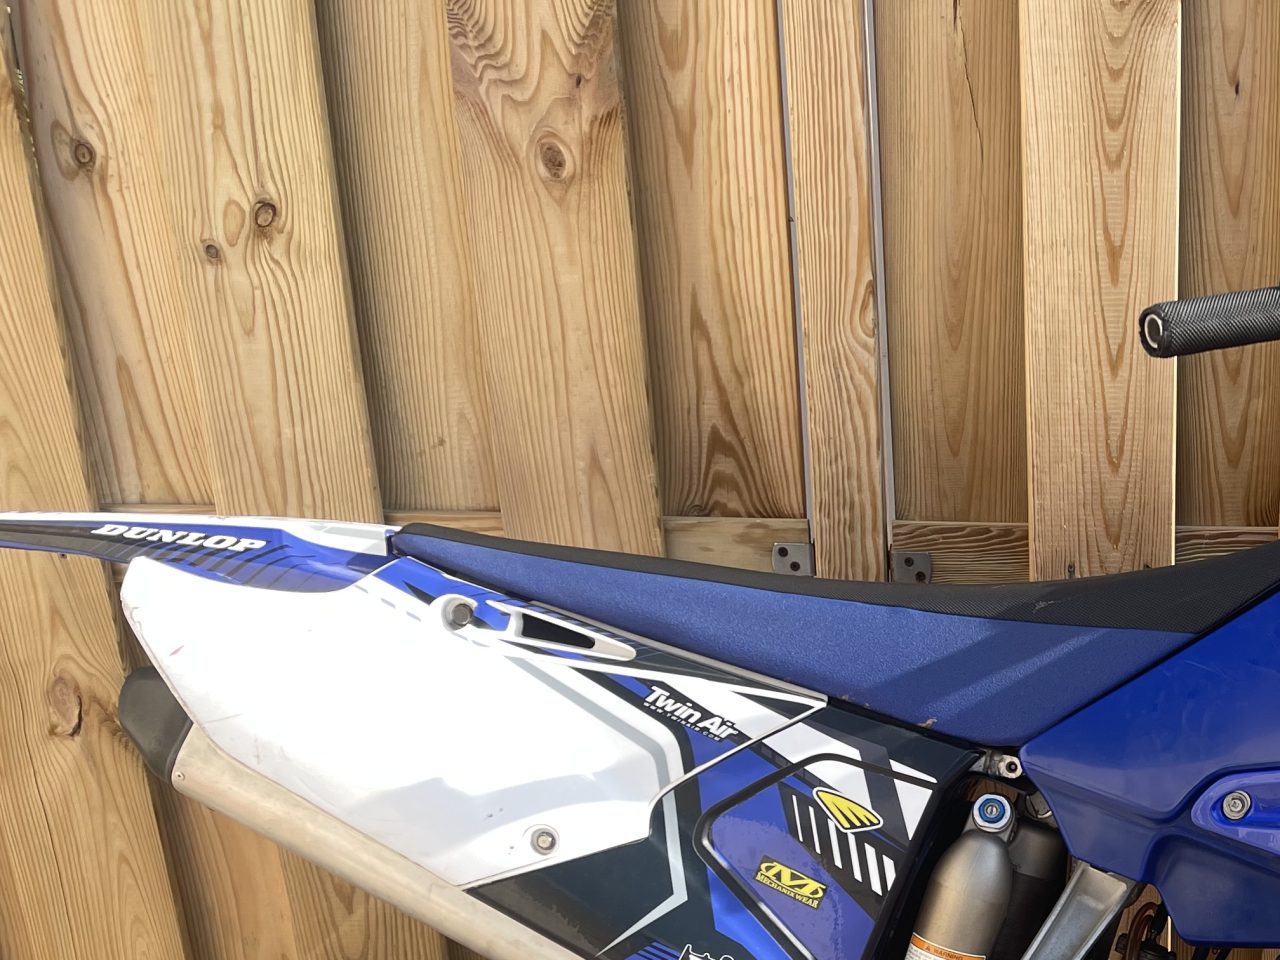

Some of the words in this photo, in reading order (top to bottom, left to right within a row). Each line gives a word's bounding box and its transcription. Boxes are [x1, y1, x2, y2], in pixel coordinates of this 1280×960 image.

[91, 524, 267, 552] DUNLOP
[645, 686, 702, 723] Twin
[700, 716, 739, 739] Air
[755, 872, 795, 898] MECHANIX
[795, 894, 819, 908] WEAR
[933, 947, 963, 960] WARNING
